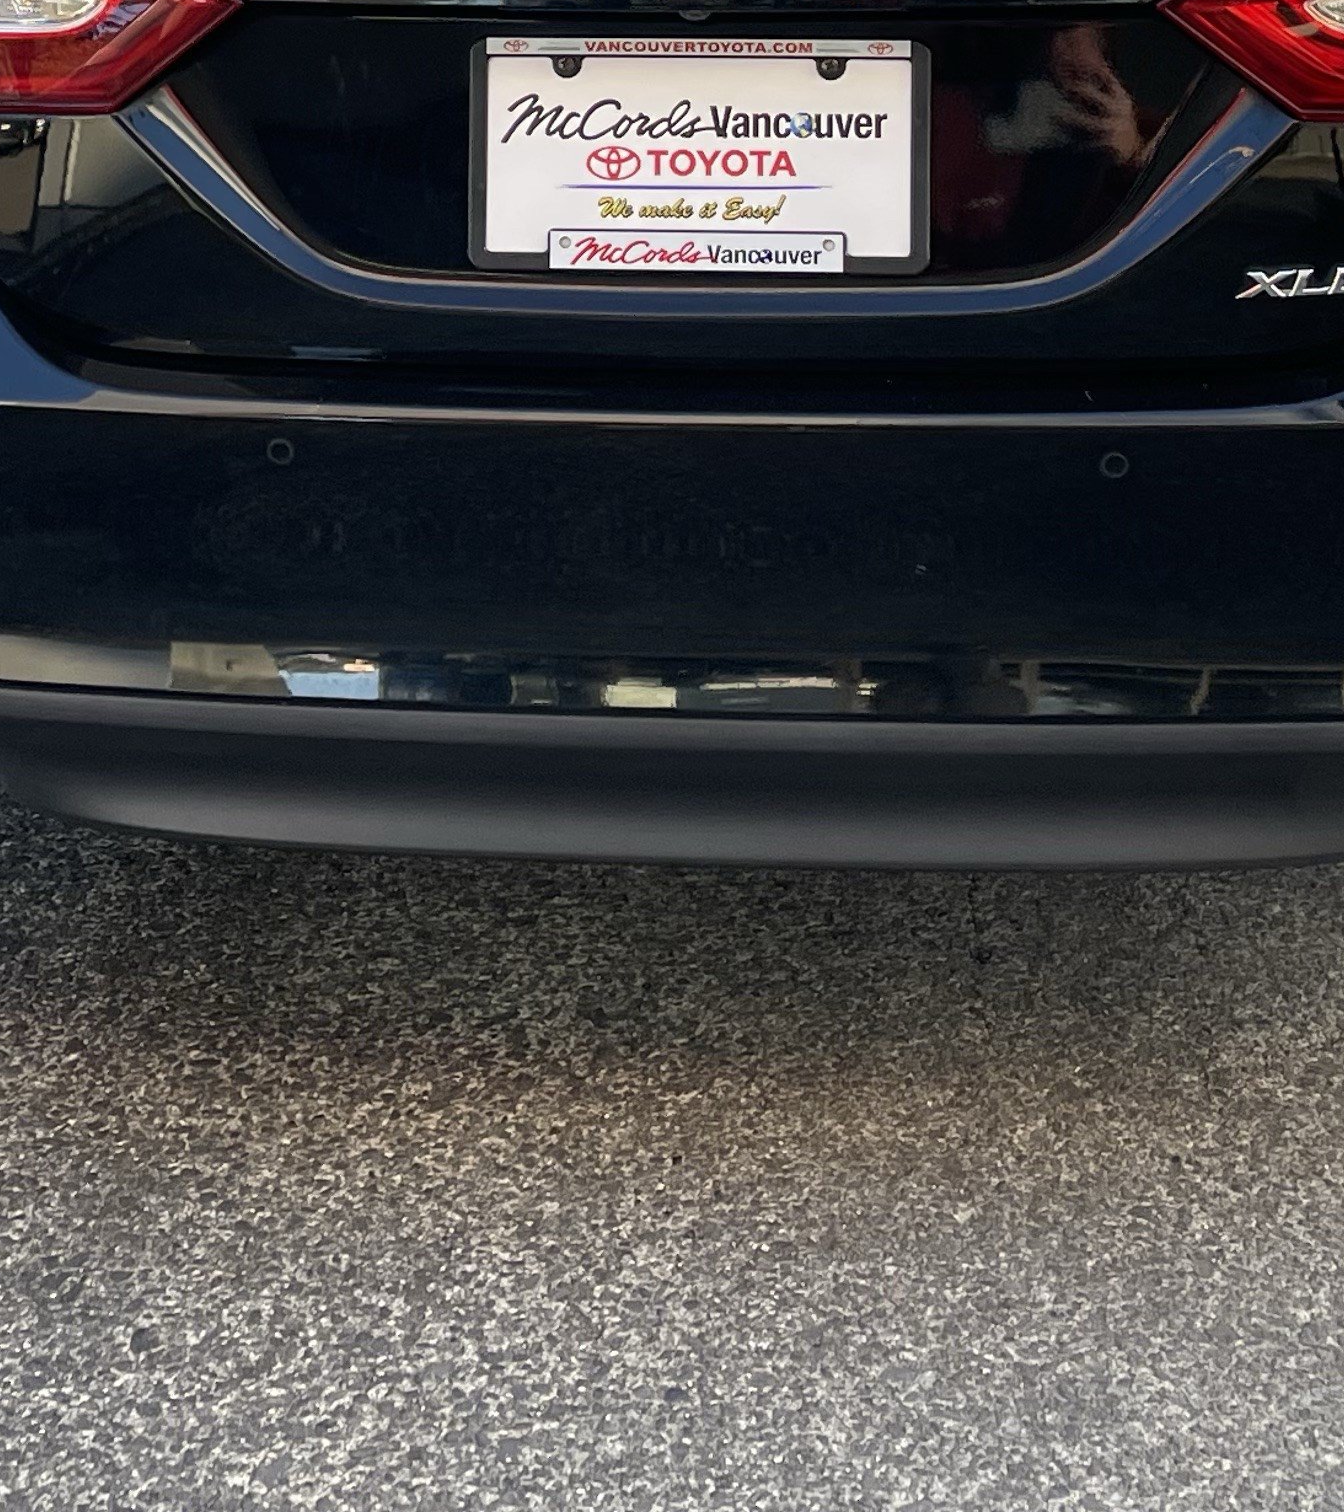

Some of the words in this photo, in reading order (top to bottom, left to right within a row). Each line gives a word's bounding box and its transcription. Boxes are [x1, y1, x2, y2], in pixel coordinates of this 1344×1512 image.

[584, 40, 813, 55] VANCOUVERTOYOTA.COM
[709, 104, 888, 140] Vancouver
[647, 149, 797, 178] TOYOTA
[598, 197, 634, 218] We
[638, 196, 694, 219] make
[699, 195, 716, 218] it
[722, 194, 787, 224] Easy!
[708, 245, 822, 265] Vancouver
